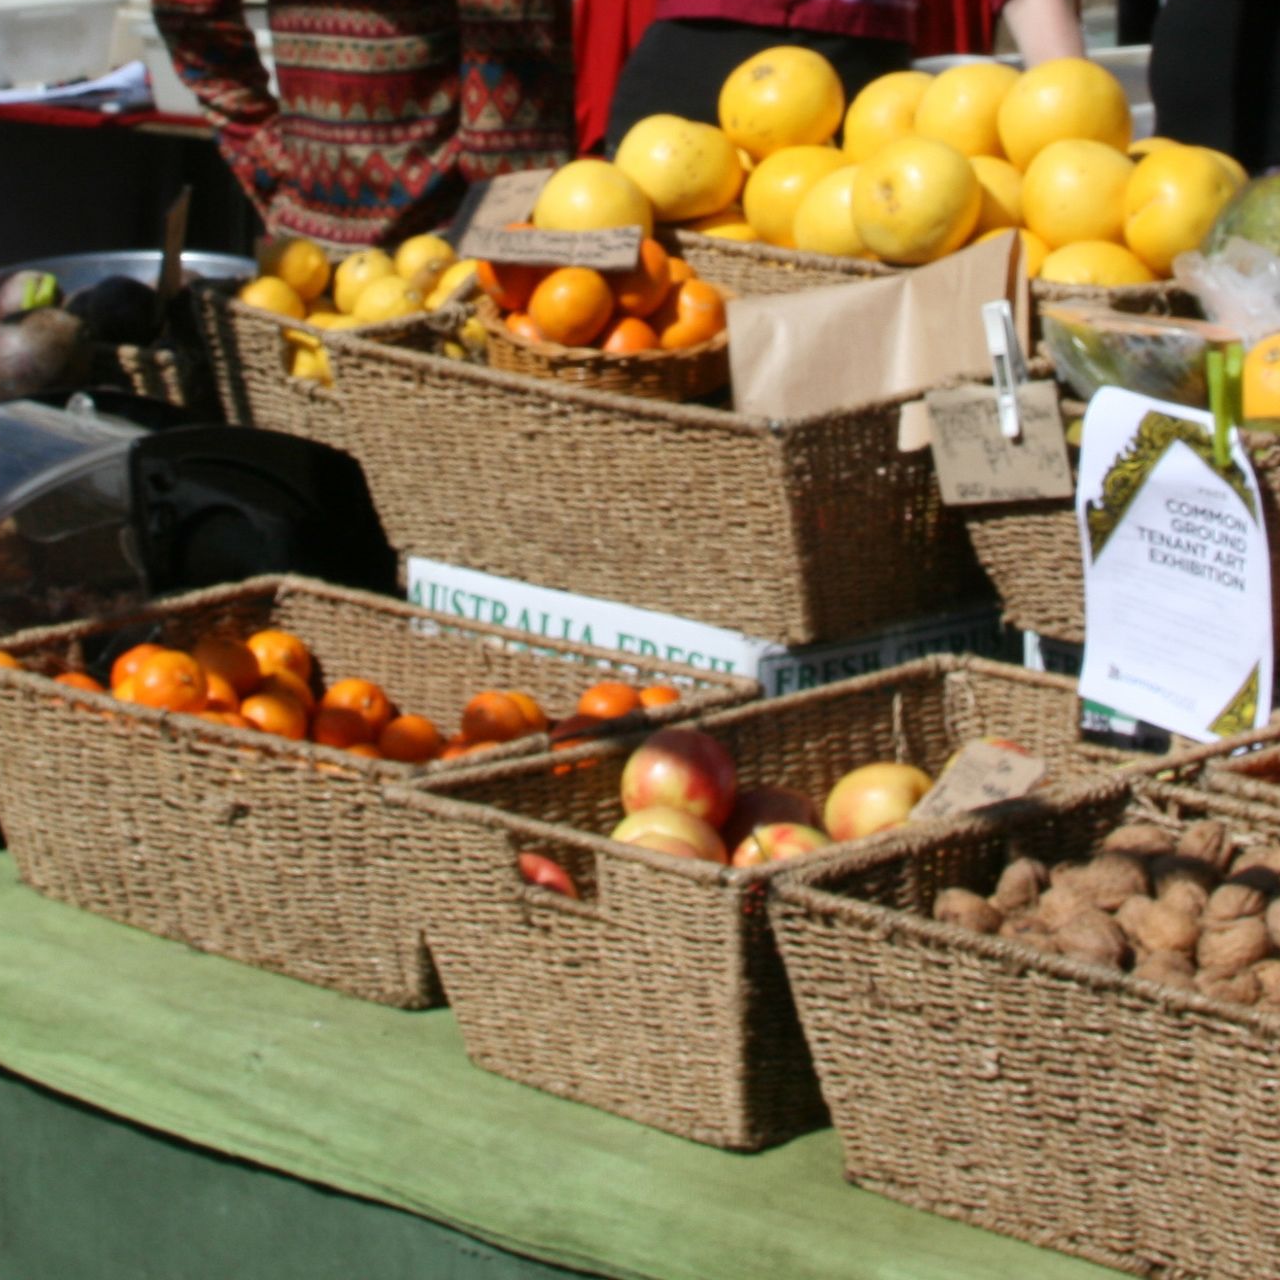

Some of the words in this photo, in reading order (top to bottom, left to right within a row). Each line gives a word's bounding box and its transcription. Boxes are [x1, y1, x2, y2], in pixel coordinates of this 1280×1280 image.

[1166, 498, 1248, 534] COMMON
[1138, 526, 1207, 559] TENANT
[1214, 550, 1245, 573] ART
[1171, 518, 1247, 554] GROUND
[1149, 548, 1245, 591] EXHIBITION
